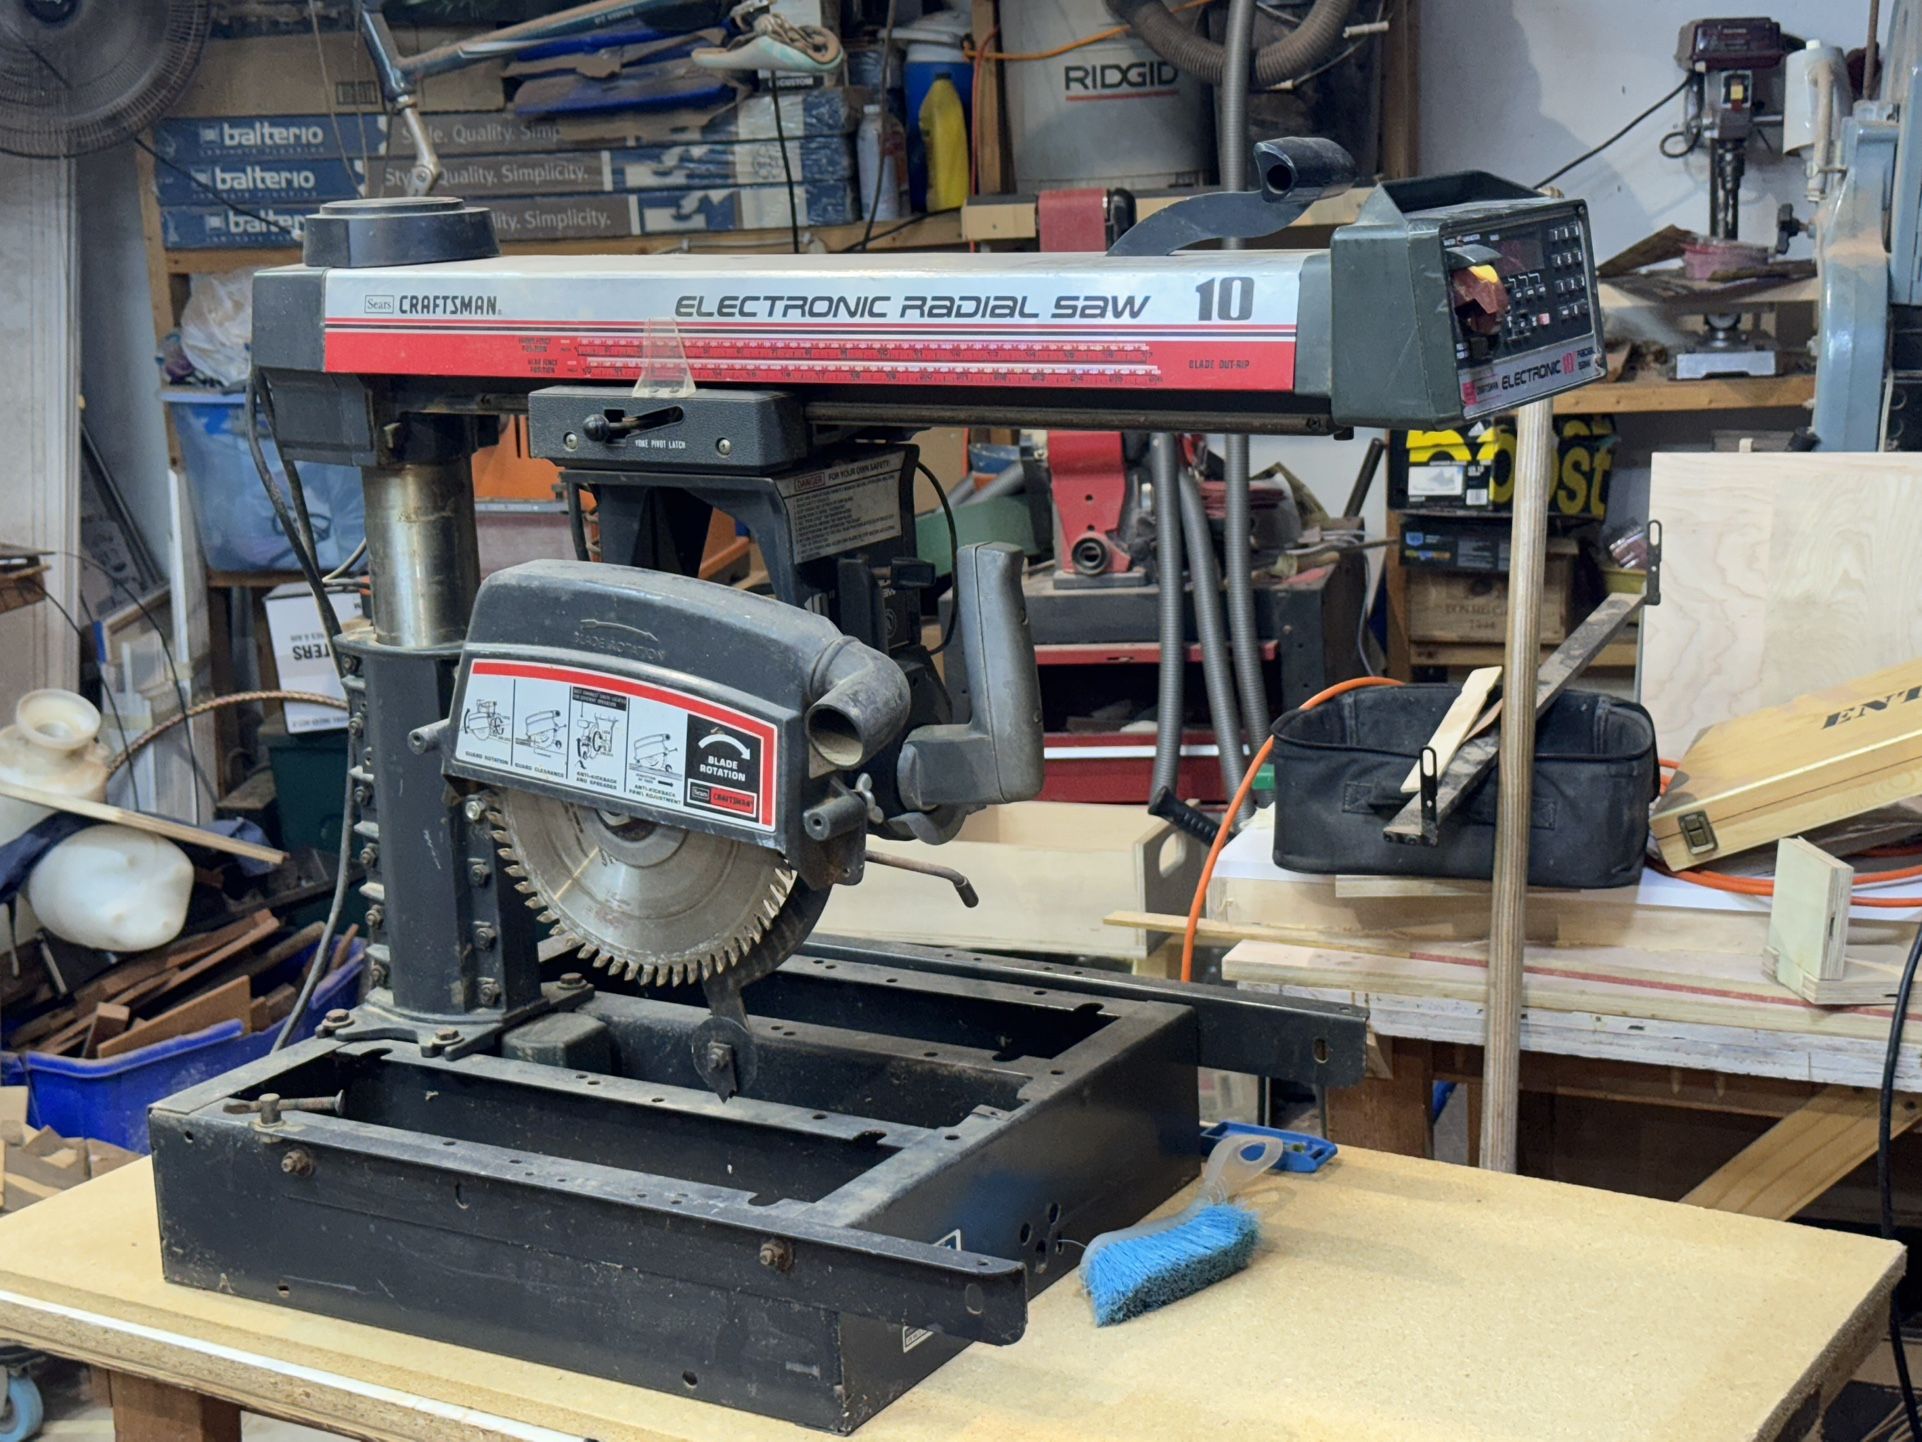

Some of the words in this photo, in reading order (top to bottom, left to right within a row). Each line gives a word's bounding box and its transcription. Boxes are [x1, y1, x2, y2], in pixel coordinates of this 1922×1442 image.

[1065, 59, 1180, 91] RIDGID
[223, 121, 323, 146] balterio
[215, 165, 315, 190] balterio
[501, 164, 589, 185] Simplicity.
[524, 210, 612, 231] Simplicity.
[367, 298, 392, 310] Sears
[675, 295, 891, 318] ELECTRONIC
[1195, 276, 1255, 321] 10
[1502, 360, 1561, 390] ELECTRONIC
[651, 440, 666, 448] PIVOT
[668, 441, 686, 449] LATCH
[841, 468, 855, 478] YOUR
[699, 764, 746, 782] ROTATION
[708, 756, 739, 770] BLADE
